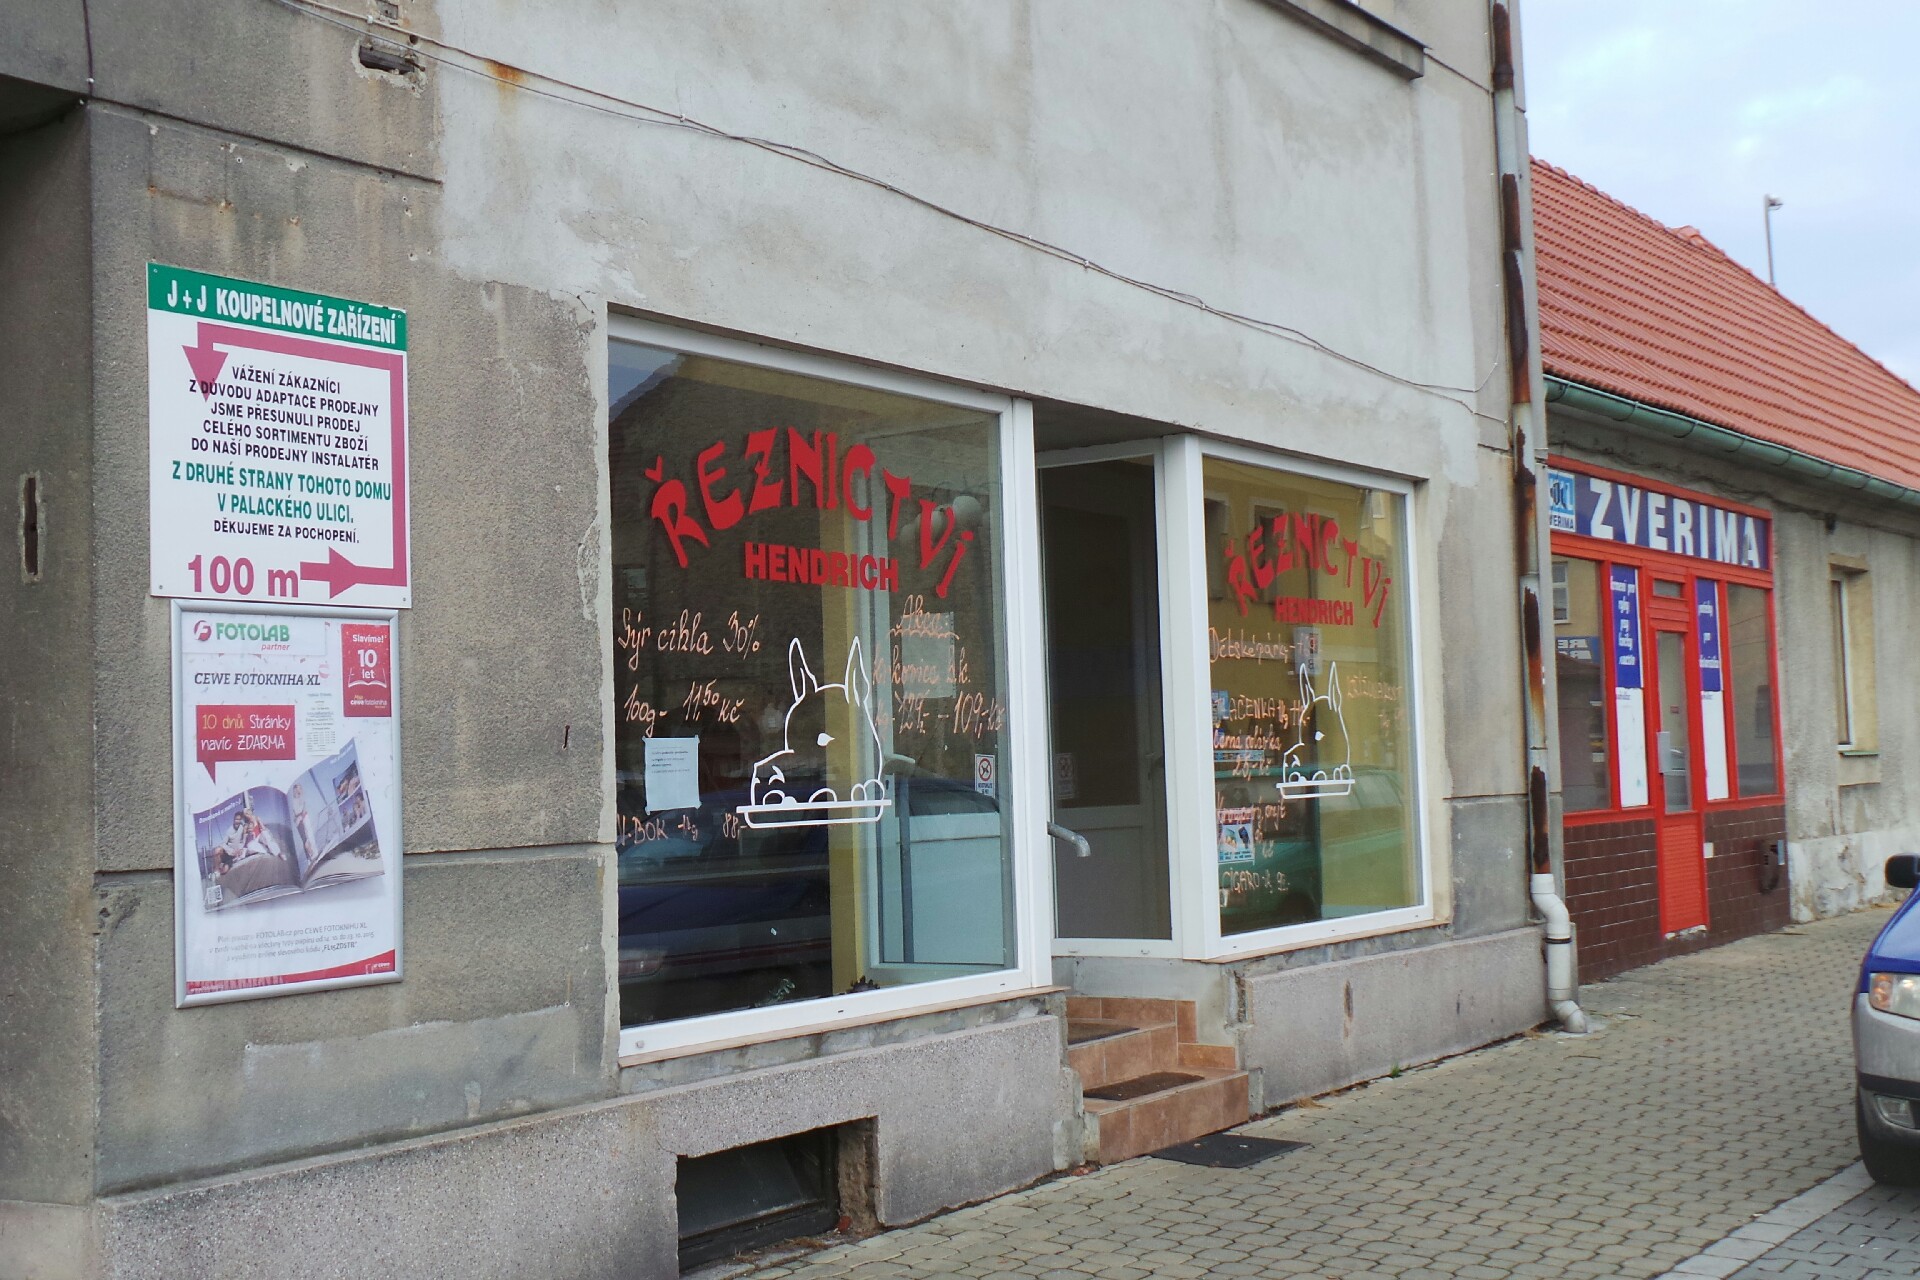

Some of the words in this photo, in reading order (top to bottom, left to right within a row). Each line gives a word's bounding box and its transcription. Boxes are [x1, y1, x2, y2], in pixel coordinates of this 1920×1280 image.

[168, 280, 177, 307] J
[197, 285, 206, 312] J
[216, 288, 323, 332] KOUPELNOVÉ
[328, 305, 396, 344] ZAŘÍZENÍ
[232, 365, 275, 385] VÁŽENÍ
[279, 372, 340, 394] ZÁKAZNÍCI
[189, 380, 197, 392] Z
[201, 379, 252, 400] DŮVODU
[256, 389, 316, 409] ADAPTACE
[320, 398, 378, 417] PRODEJNY
[211, 402, 243, 418] JSME
[247, 404, 313, 427] PŘESUNULI
[317, 415, 360, 433] PRODEJ
[203, 417, 251, 438] CELÉHO
[256, 426, 331, 447] SORTIMENTU
[335, 434, 368, 452] ZBOŽÍ
[192, 438, 208, 452] DO
[212, 438, 241, 456] NAŠÍ
[246, 444, 308, 464] PRODEJNY
[312, 451, 378, 471] INSTALATÉR
[172, 460, 181, 480] Z
[186, 461, 234, 486] DRUHÉ
[239, 468, 294, 492] STRANY
[298, 474, 350, 497] TOHOTO
[356, 480, 391, 500] DOMU
[218, 493, 226, 512] V
[231, 495, 312, 520] PALACKÉHO
[316, 503, 354, 523] ULICI.
[1590, 478, 1760, 568] ZVERIMA
[214, 518, 274, 536] DĚKUJEME
[278, 525, 292, 538] ZA
[296, 527, 360, 544] POCHOPENÍ.
[188, 554, 254, 596] 100
[267, 568, 298, 598] m
[744, 541, 898, 592] HENDRICH
[1274, 595, 1354, 626] HENDRICH
[216, 622, 290, 642] FOTOLAB
[261, 643, 290, 651] partner
[358, 650, 378, 668] 10
[362, 669, 374, 679] let
[194, 672, 230, 685] CEWE
[234, 673, 304, 686] FOTOKNIHA
[306, 674, 320, 686] XL
[202, 714, 216, 729] 10
[222, 714, 244, 729] dnů
[250, 714, 291, 730] Stránky
[201, 736, 232, 750] navíc
[238, 734, 286, 750] ZDARMA
